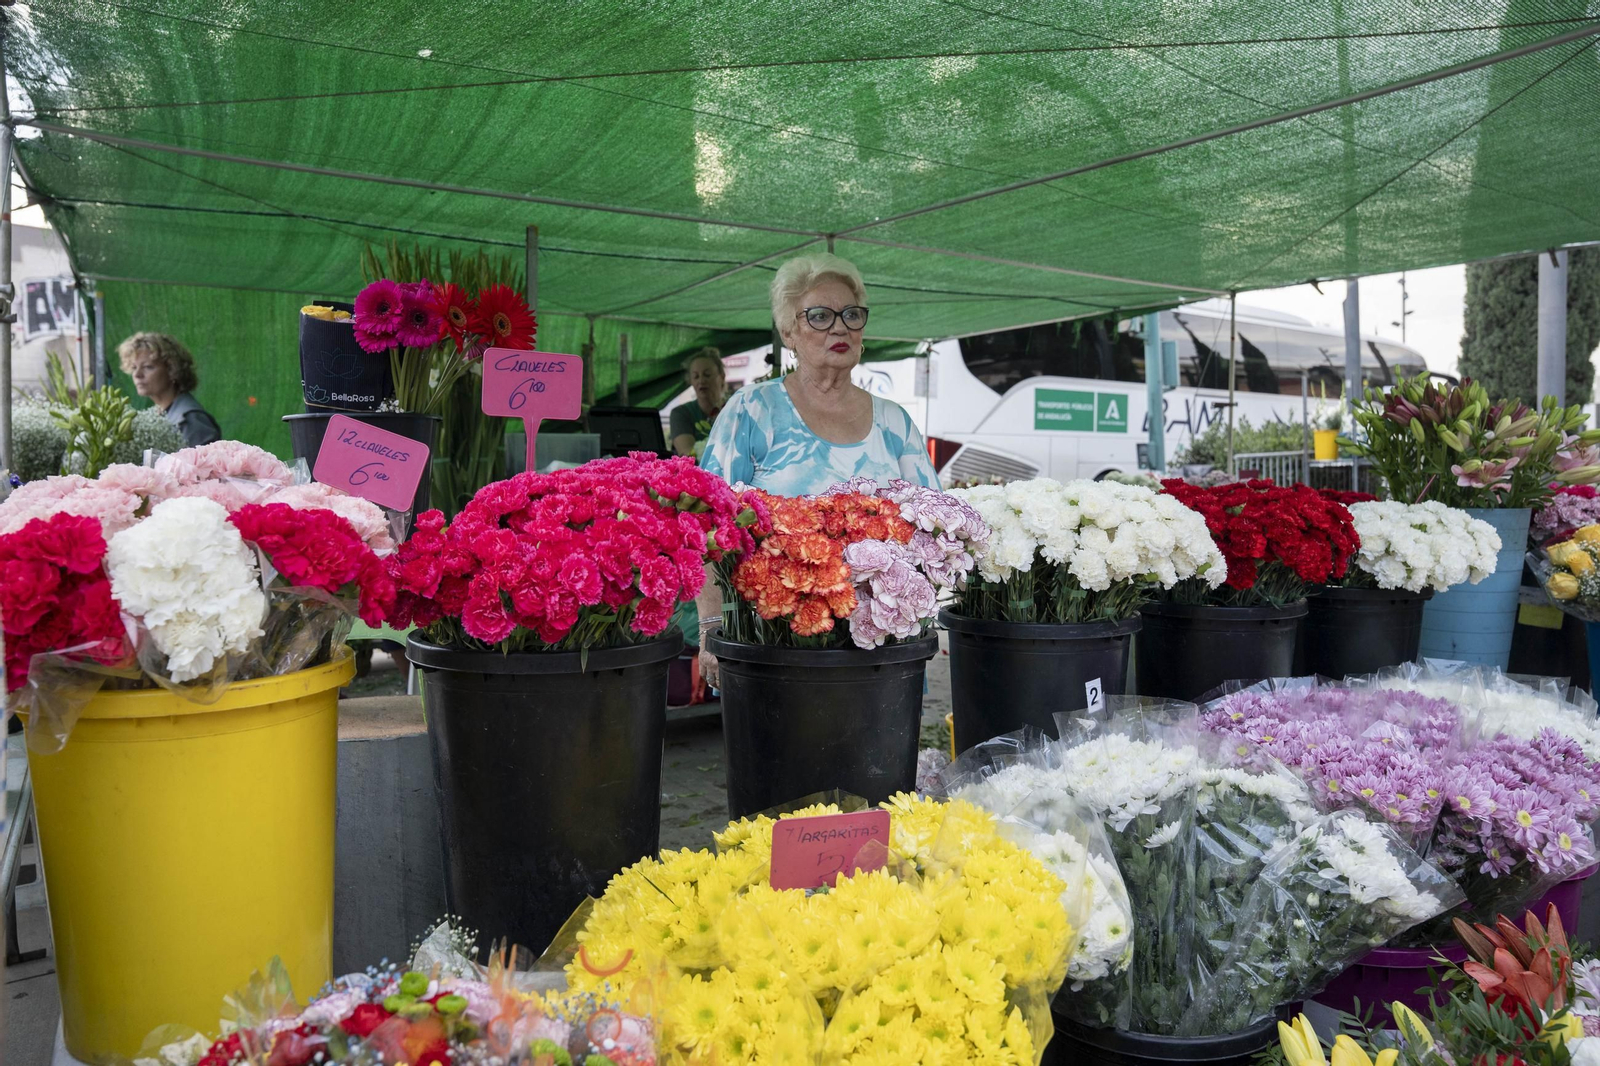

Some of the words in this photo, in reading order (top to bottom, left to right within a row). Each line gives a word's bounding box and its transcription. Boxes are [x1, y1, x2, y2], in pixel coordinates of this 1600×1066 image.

[494, 354, 567, 373] CLAVELES
[331, 392, 375, 403] BellaRosa
[1090, 687, 1099, 706] 2
